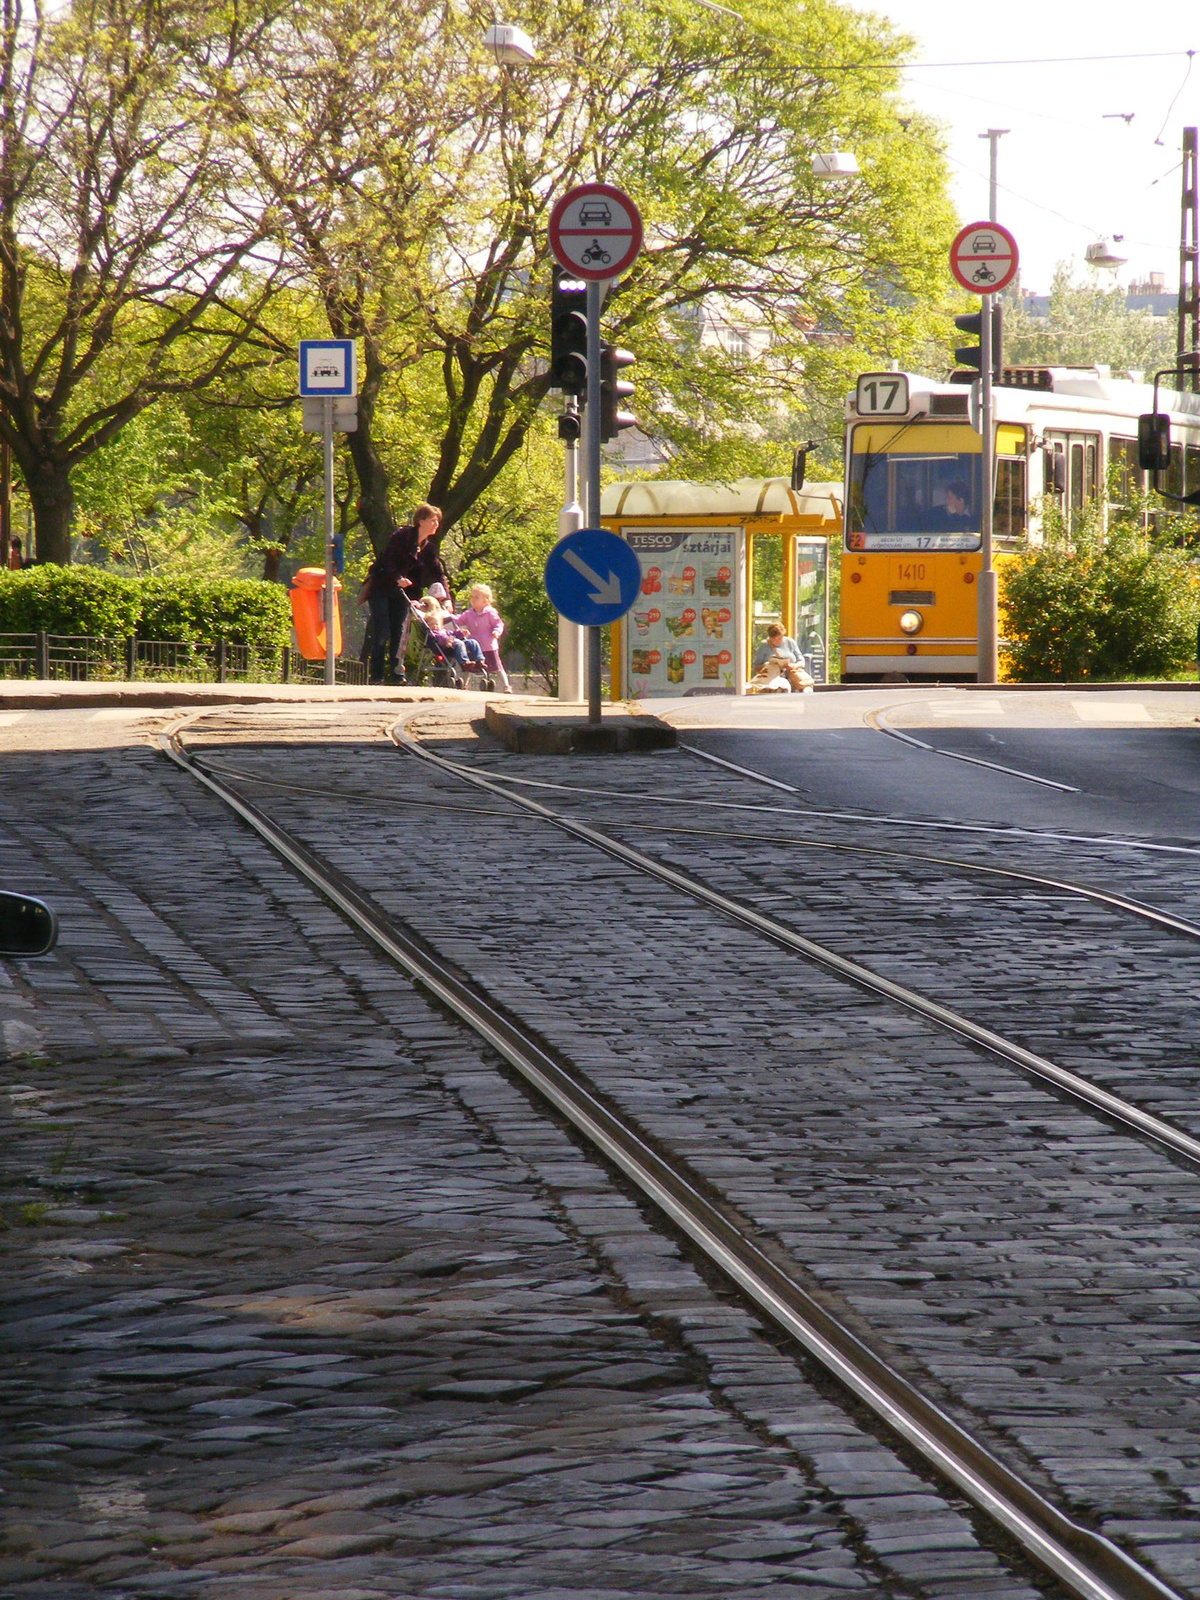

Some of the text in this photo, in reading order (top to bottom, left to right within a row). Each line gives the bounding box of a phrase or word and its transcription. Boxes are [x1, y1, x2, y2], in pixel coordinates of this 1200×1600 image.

[863, 380, 900, 410] 17
[632, 535, 673, 545] TESCO
[682, 540, 731, 556] sztárjai
[916, 537, 932, 548] 17
[898, 563, 926, 580] 1410
